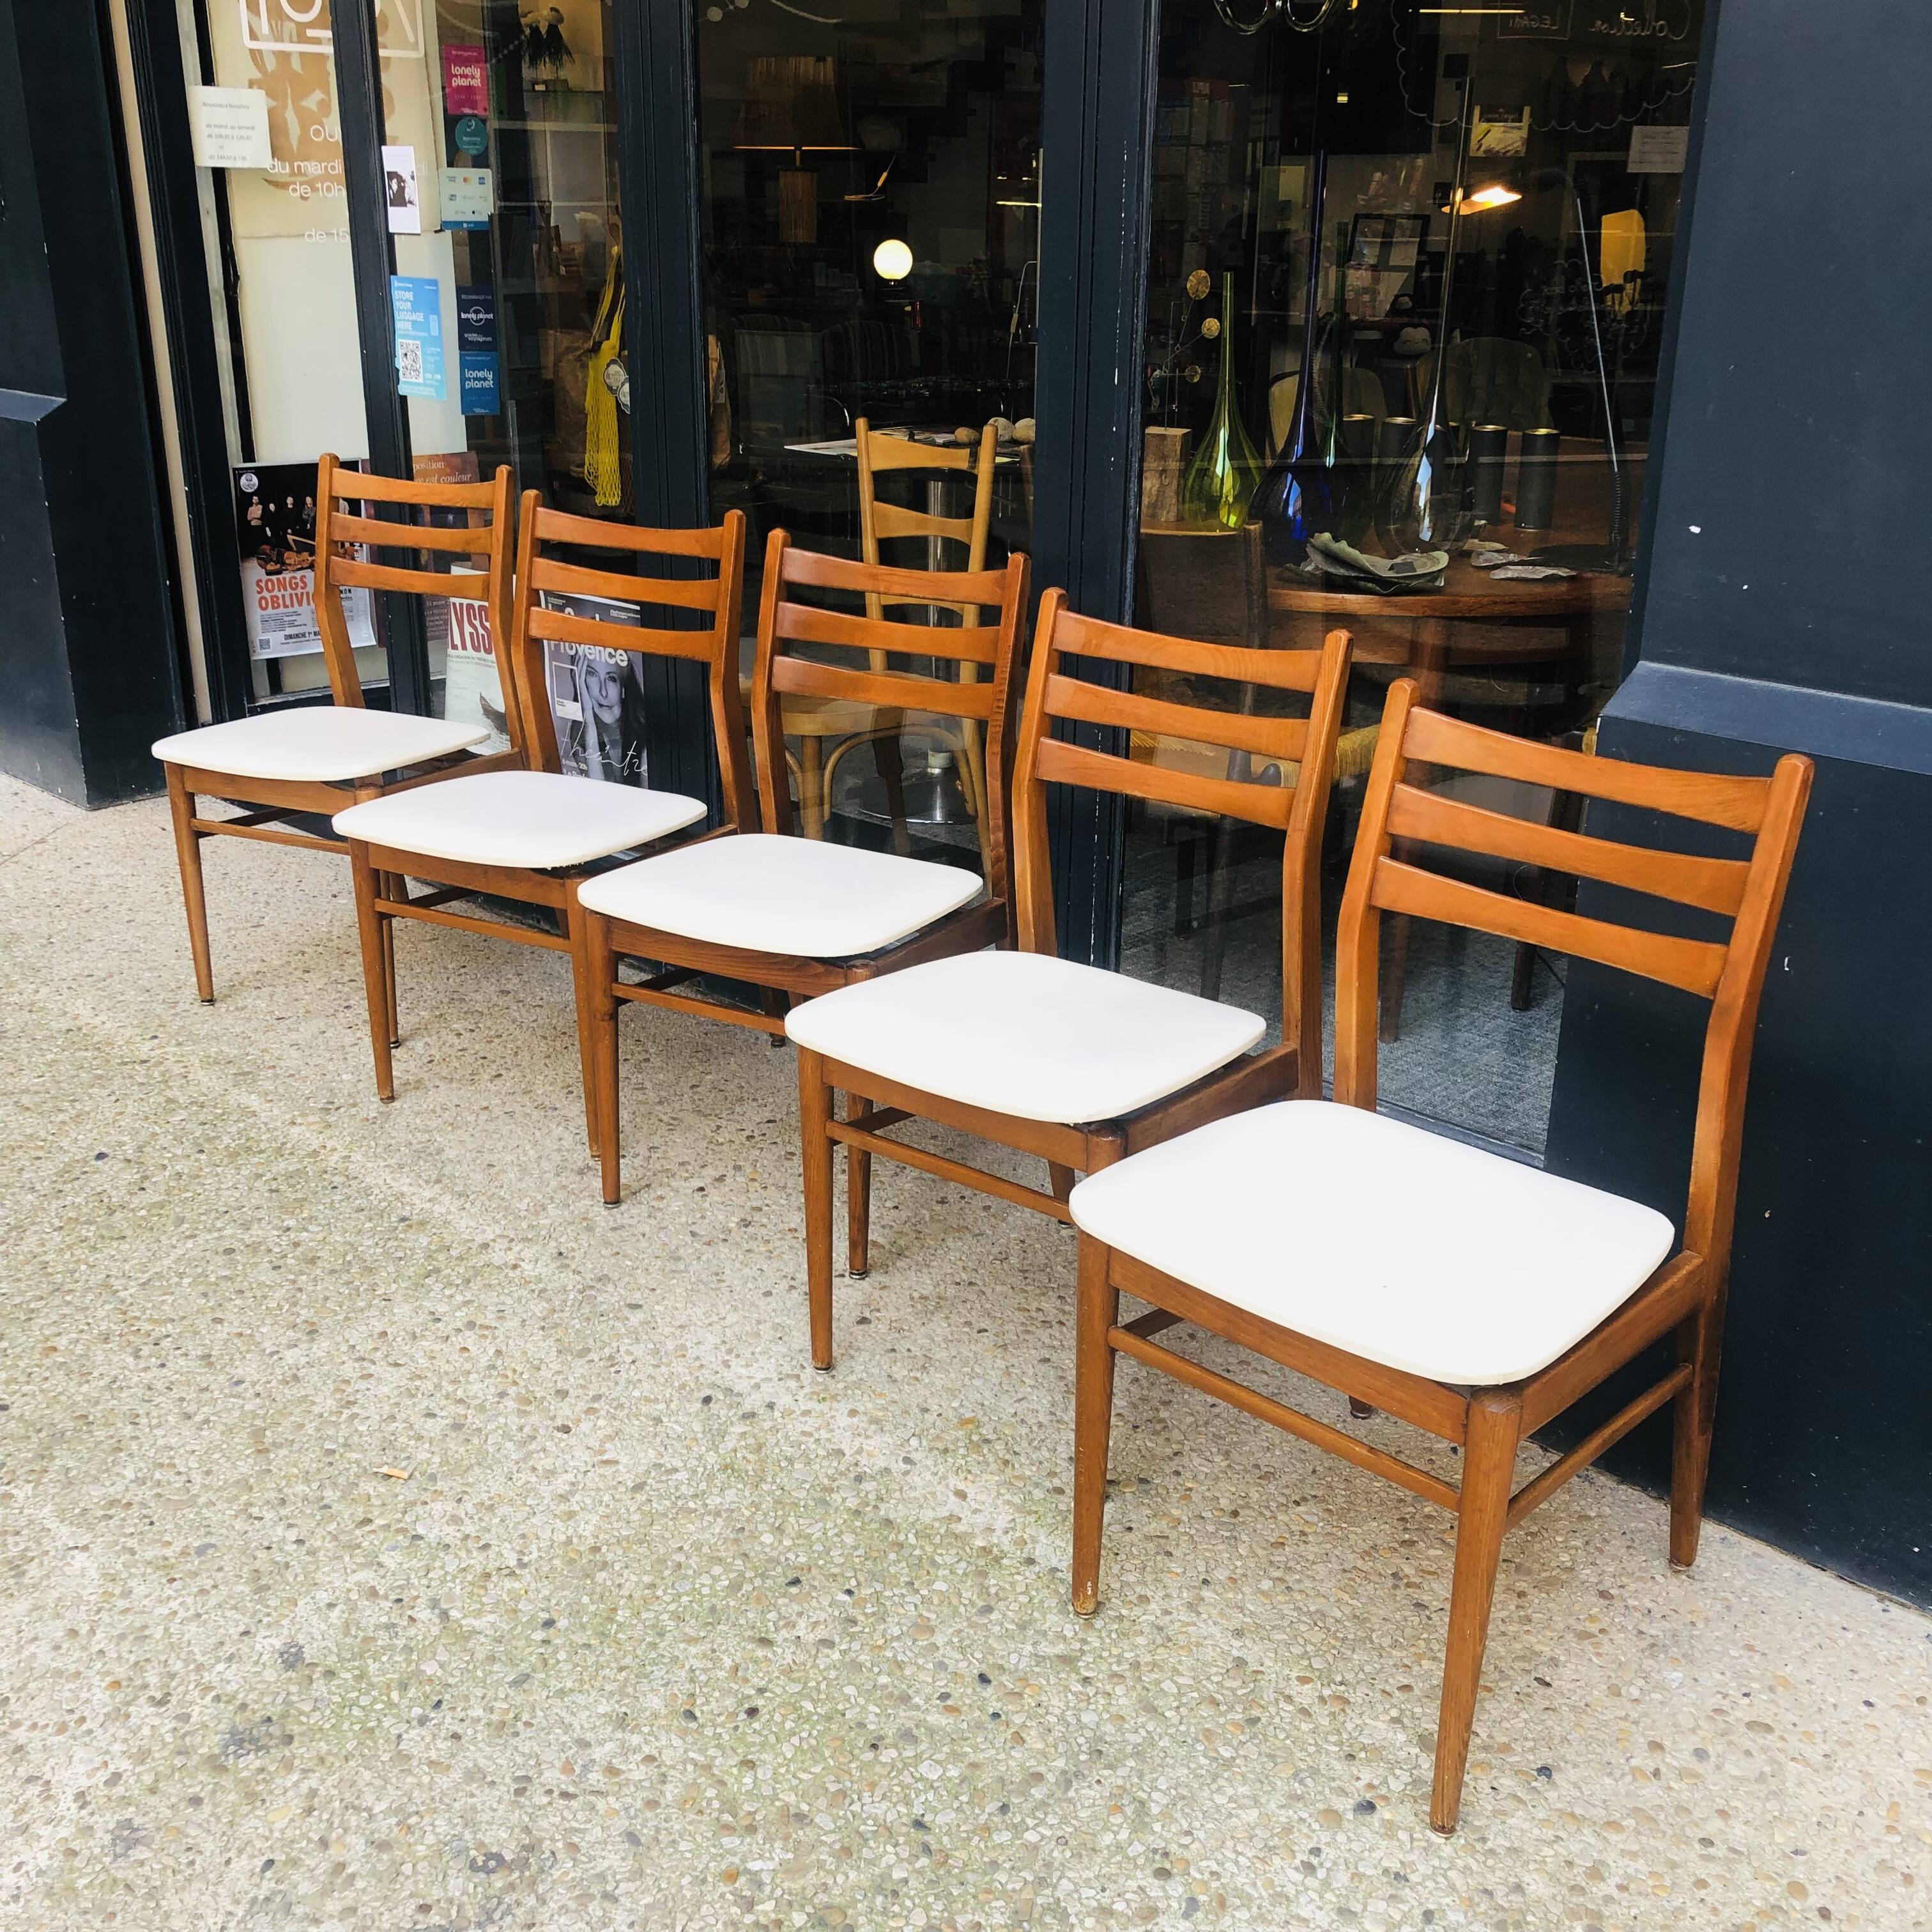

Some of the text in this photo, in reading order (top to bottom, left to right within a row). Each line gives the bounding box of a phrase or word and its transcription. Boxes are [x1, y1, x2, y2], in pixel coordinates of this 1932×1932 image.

[451, 63, 480, 78] lonely
[452, 75, 482, 88] planet
[267, 158, 289, 174] du
[294, 159, 342, 176] mardi
[288, 181, 311, 197] de
[304, 227, 326, 243] de
[394, 290, 414, 301] STORE
[395, 300, 412, 310] YOUR
[396, 310, 425, 322] LUGGAGE
[461, 311, 477, 321] lonely
[397, 320, 413, 330] HERE
[464, 368, 493, 381] lonely
[465, 379, 494, 390] planet
[413, 461, 444, 473] position
[440, 471, 471, 484] couleur
[256, 574, 308, 595] SONGS
[258, 591, 314, 611] OBLIVI
[449, 602, 493, 655] LYSS
